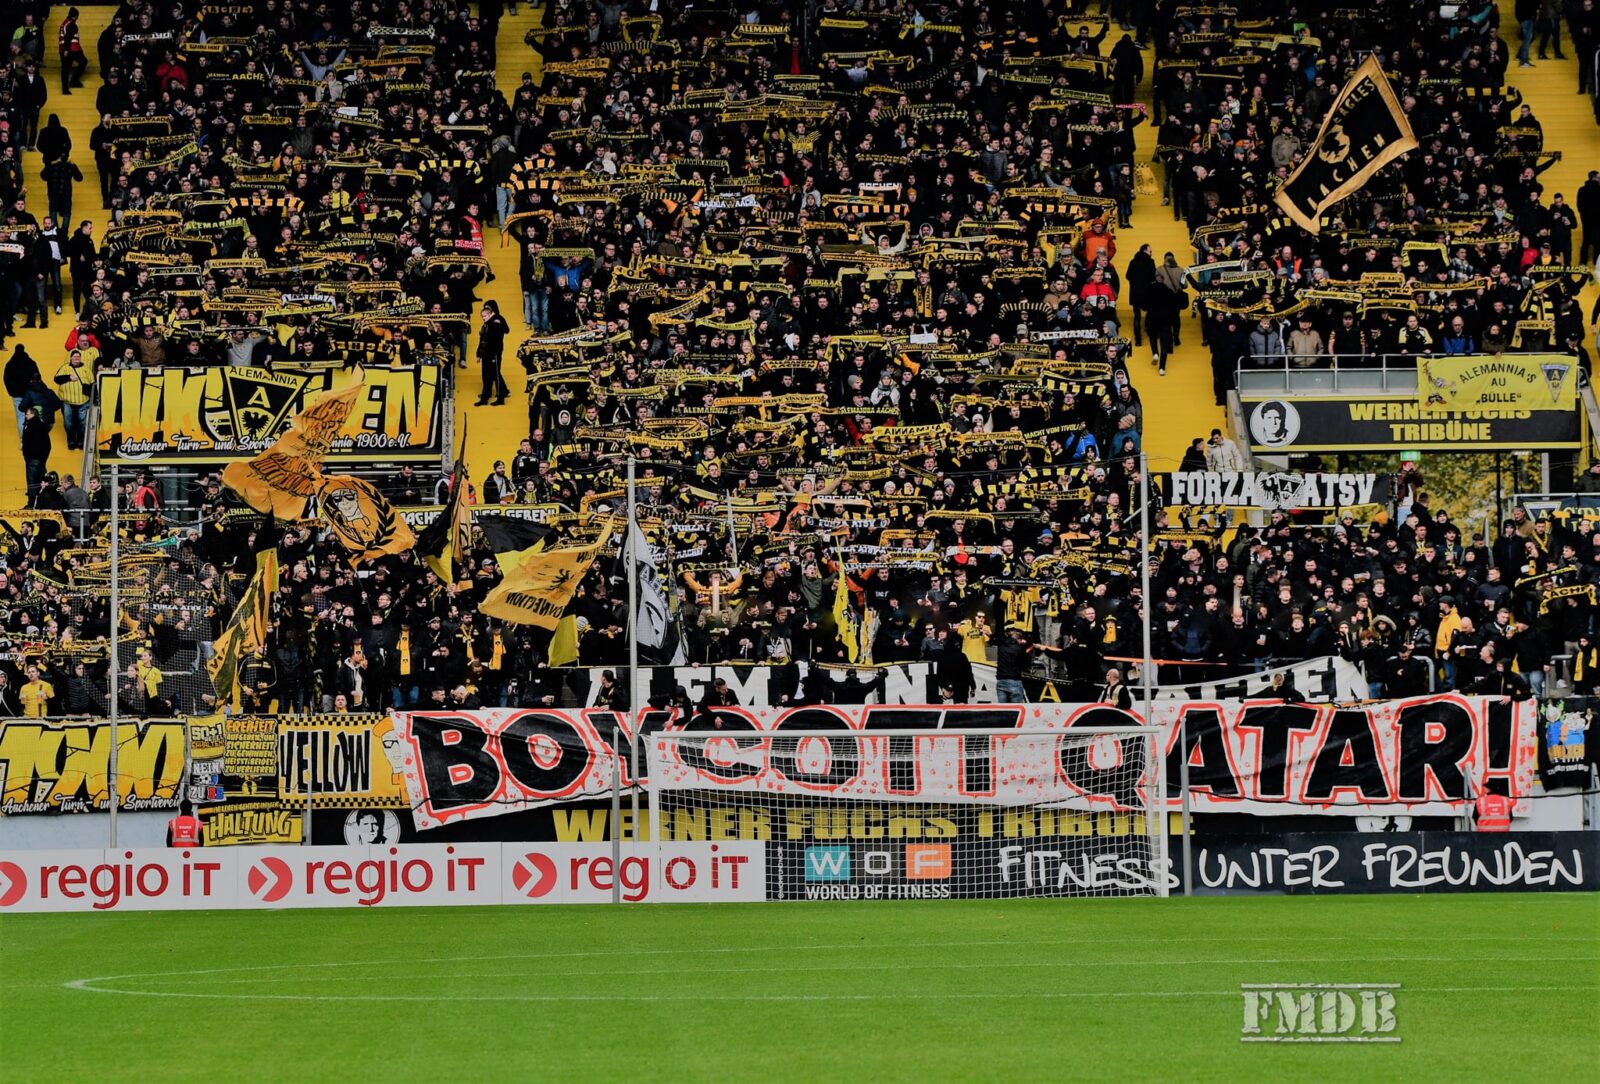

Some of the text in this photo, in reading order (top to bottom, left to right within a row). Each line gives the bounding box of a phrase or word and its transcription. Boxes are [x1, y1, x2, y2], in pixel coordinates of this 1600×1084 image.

[232, 73, 264, 82] AACHE
[1333, 79, 1375, 124] EAGLES
[1459, 362, 1537, 384] ALEMANNIA'S
[1490, 377, 1506, 387] AU
[247, 385, 271, 409] A
[1389, 420, 1492, 441] TRIBÜNE
[120, 437, 168, 454] Aachener
[172, 434, 208, 452] Turn-
[214, 439, 234, 452] und
[356, 435, 387, 450] 1900
[1171, 471, 1377, 507] FORZA ATSV
[226, 719, 276, 734] FREIHEIT
[226, 741, 274, 750] SICHERHEIT
[191, 762, 220, 775] NEIN
[280, 730, 371, 793] YELLOW
[408, 694, 1519, 822] BOYCOTT QATAR!
[190, 786, 206, 799] ZU
[1, 796, 50, 813] Aachener
[209, 810, 291, 841] HALTUNG
[997, 841, 1584, 890] FITNESS UNTER FREUNDEN
[40, 850, 169, 910] regio
[306, 847, 433, 906] regio
[569, 856, 697, 902] rego
[806, 883, 950, 900] WORLD OF FITNESS
